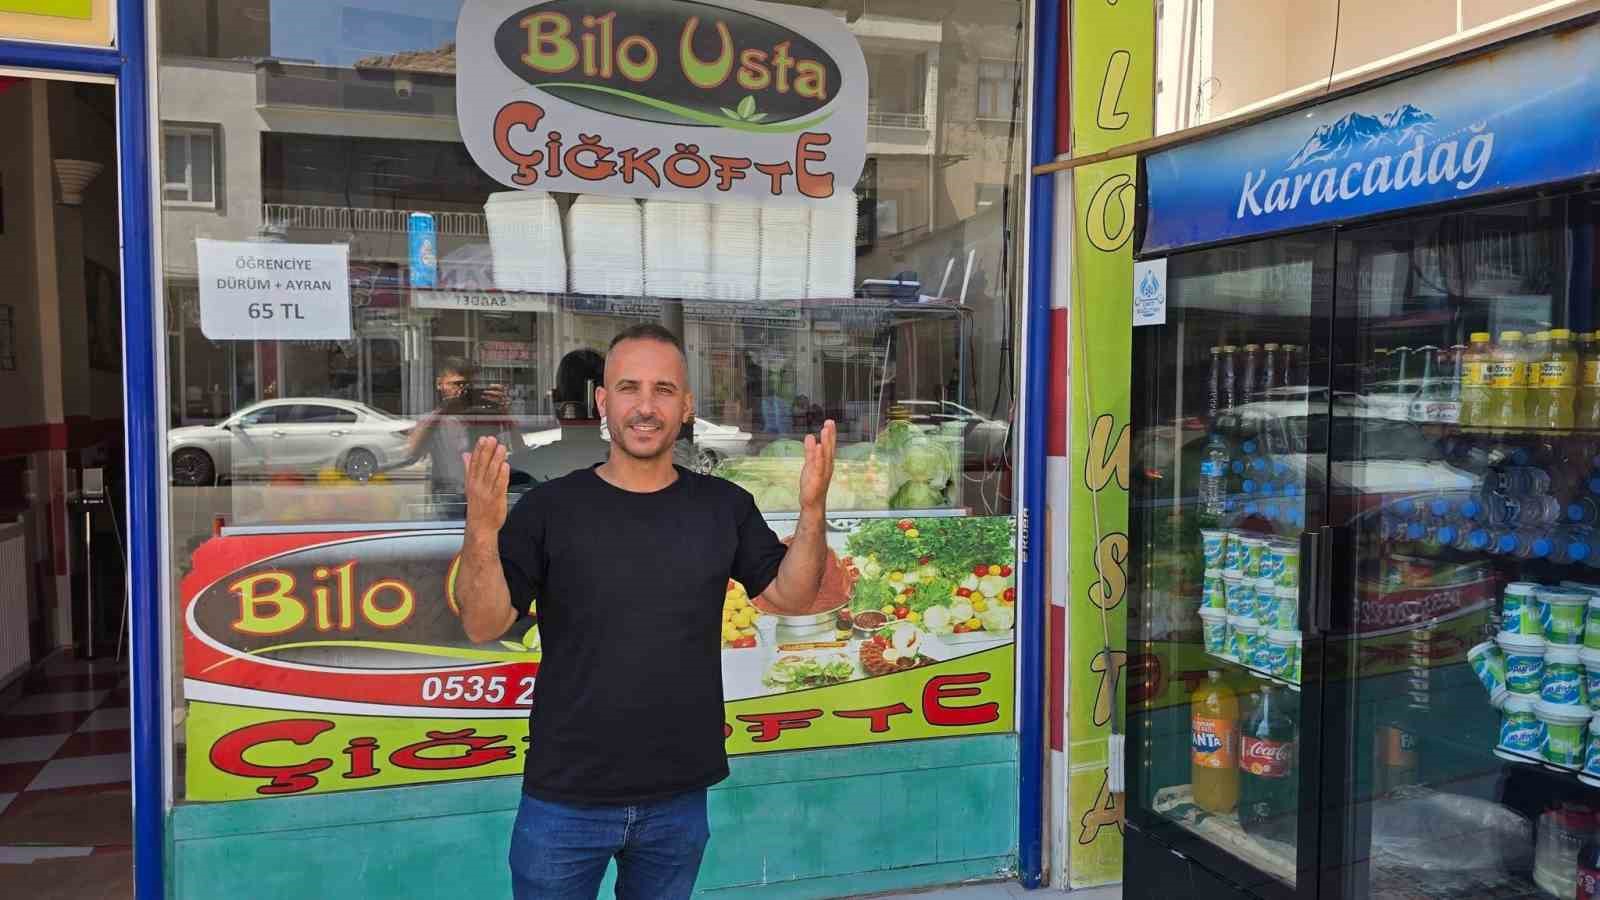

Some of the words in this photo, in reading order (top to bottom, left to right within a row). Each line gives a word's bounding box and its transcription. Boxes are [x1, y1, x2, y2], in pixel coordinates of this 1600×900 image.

[520, 10, 658, 82] Bilo
[679, 16, 827, 100] Usta
[1236, 121, 1496, 219] Karacadağ
[235, 256, 312, 270] ÖĞRENCİYE
[216, 277, 271, 290] DÜRÜM
[285, 280, 332, 291] AYRAN
[248, 303, 274, 319] 65
[280, 303, 305, 320] TL
[227, 561, 415, 636] Bilo
[422, 676, 508, 704] 0535
[1192, 732, 1221, 747] ANTA
